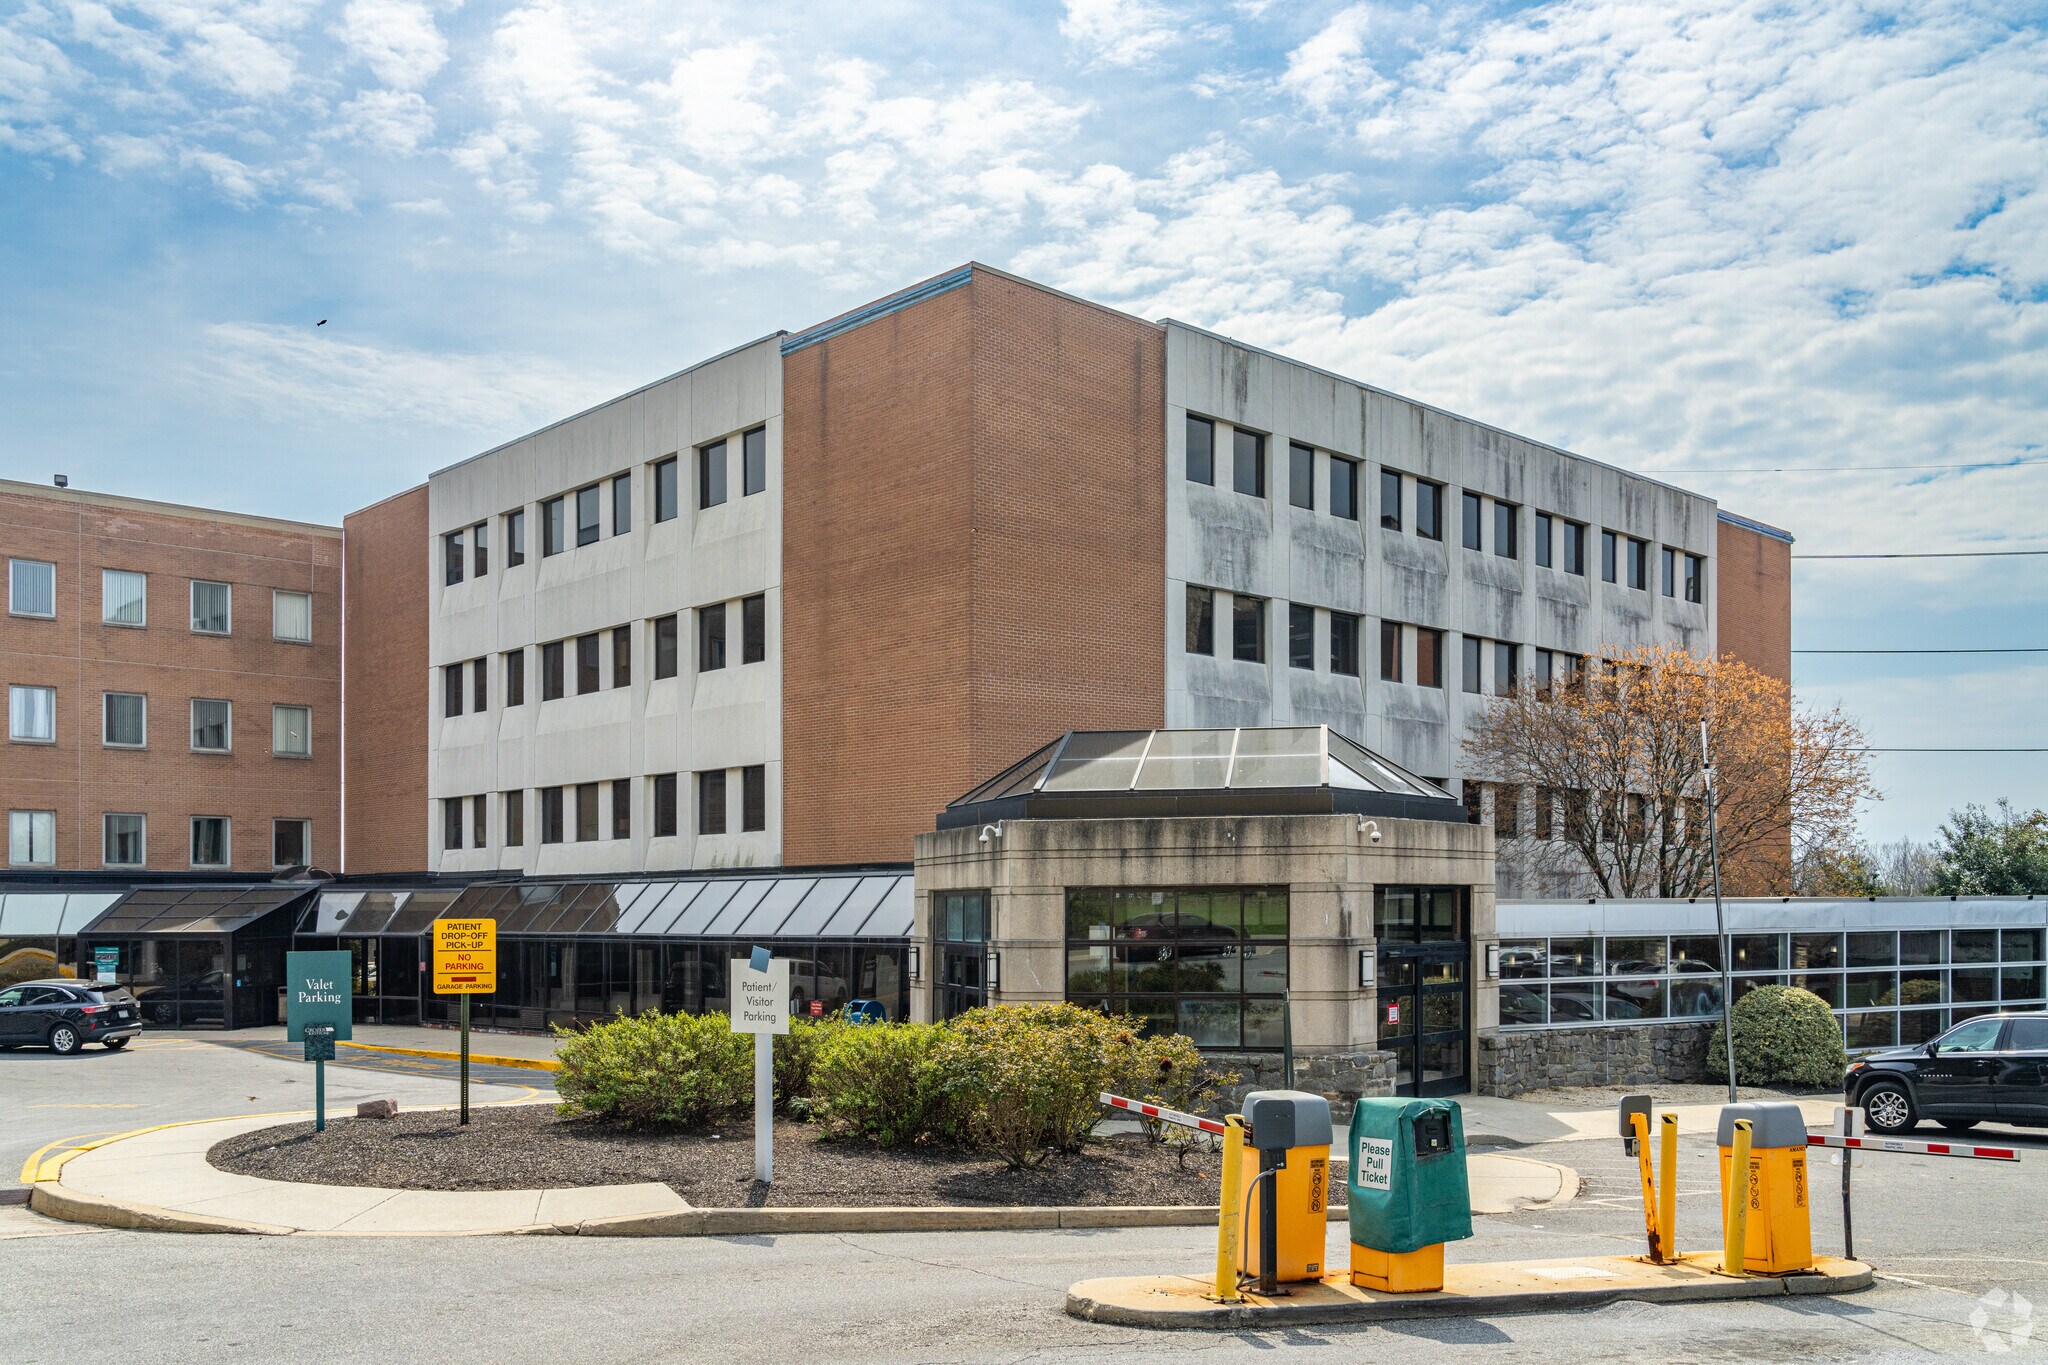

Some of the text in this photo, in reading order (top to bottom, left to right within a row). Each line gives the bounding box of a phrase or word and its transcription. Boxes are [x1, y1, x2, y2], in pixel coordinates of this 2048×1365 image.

[457, 953, 471, 961] NO
[445, 962, 484, 970] PARKING
[305, 978, 333, 990] Valet
[742, 981, 777, 992] Patient/
[298, 991, 342, 1005] Parking
[746, 996, 774, 1006] Visitor
[744, 1010, 776, 1025] Parking
[1361, 1142, 1391, 1156] Please
[1366, 1157, 1384, 1169] Pull
[1361, 1170, 1388, 1185] Ticket
